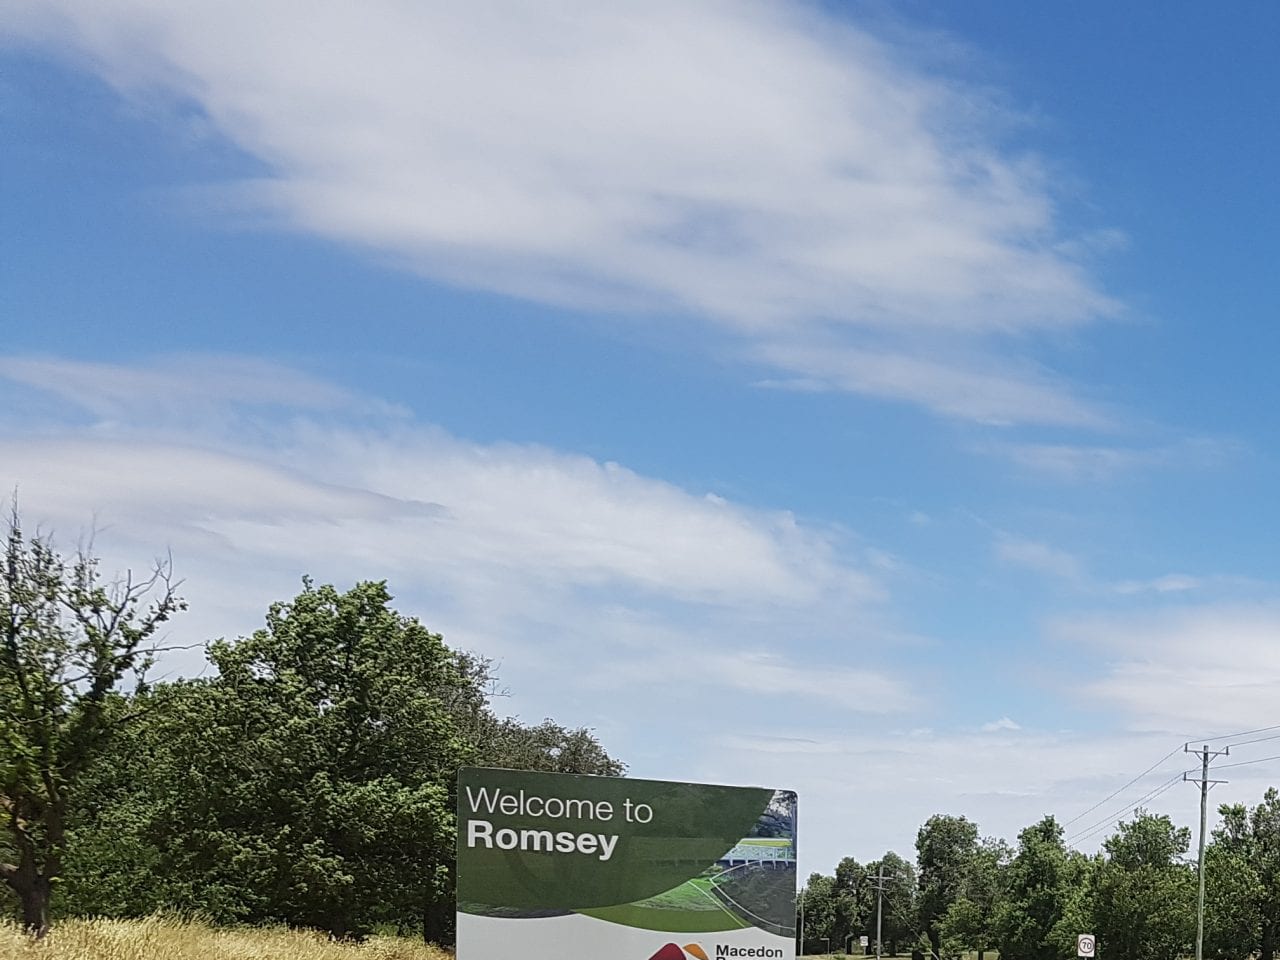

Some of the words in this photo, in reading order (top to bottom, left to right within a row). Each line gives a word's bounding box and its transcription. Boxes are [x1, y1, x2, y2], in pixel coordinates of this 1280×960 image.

[466, 786, 614, 821] Welcome
[623, 798, 653, 823] to
[466, 820, 619, 861] Romsey
[716, 944, 783, 958] Macedon
[1082, 941, 1092, 950] 70
